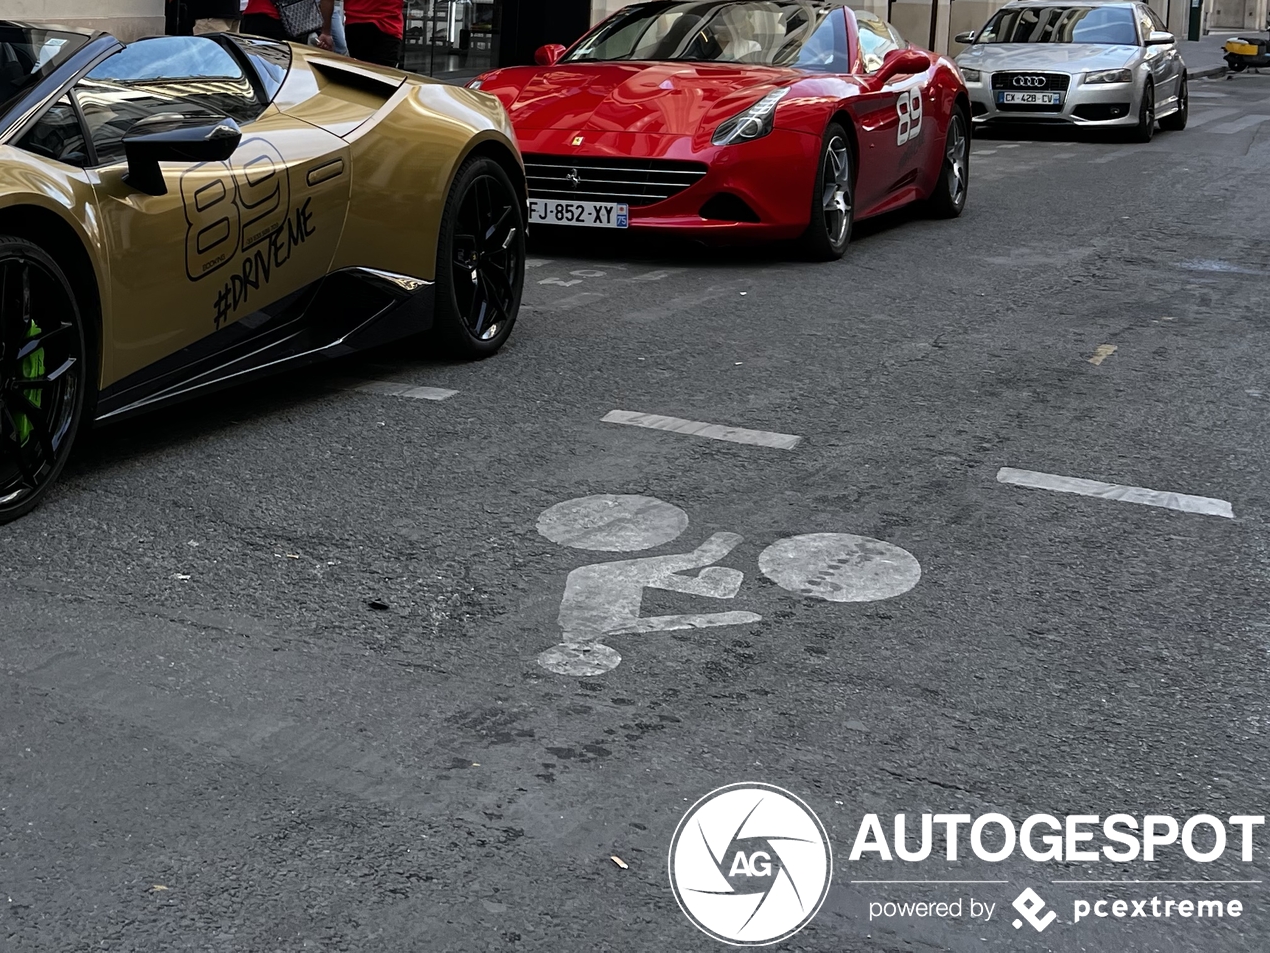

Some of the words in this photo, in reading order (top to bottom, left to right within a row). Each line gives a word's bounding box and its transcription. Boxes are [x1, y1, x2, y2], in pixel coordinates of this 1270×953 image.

[896, 86, 922, 146] 89
[529, 202, 614, 224] FJ-852-XY
[616, 215, 627, 225] 75
